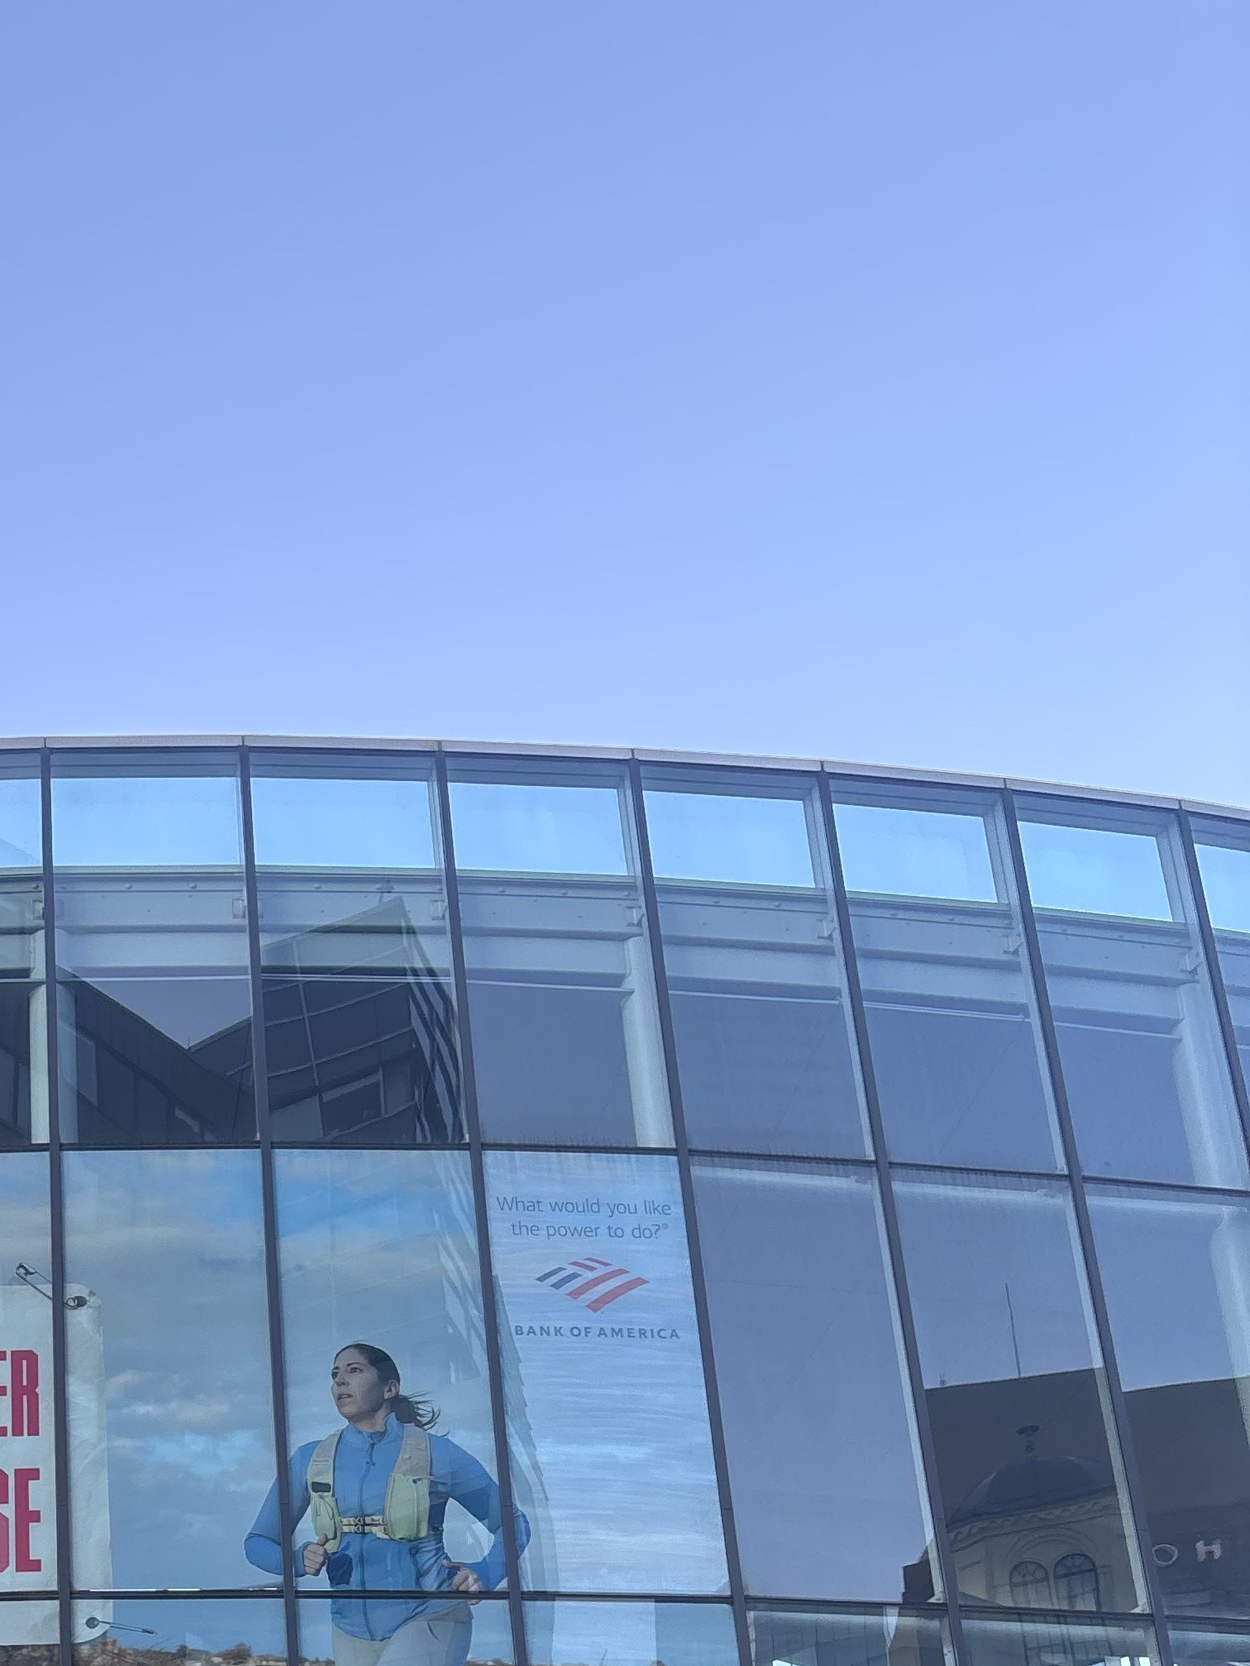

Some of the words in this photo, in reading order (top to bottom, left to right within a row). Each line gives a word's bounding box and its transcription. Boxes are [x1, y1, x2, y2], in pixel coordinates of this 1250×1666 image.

[496, 1197, 545, 1213] What
[550, 1198, 600, 1214] would
[606, 1202, 637, 1217] you
[644, 1200, 672, 1216] like
[511, 1221, 540, 1236] the
[546, 1224, 600, 1240] power
[607, 1224, 625, 1239] to
[514, 1325, 565, 1337] BANK
[570, 1326, 592, 1338] OF
[598, 1327, 680, 1340] AMERICA
